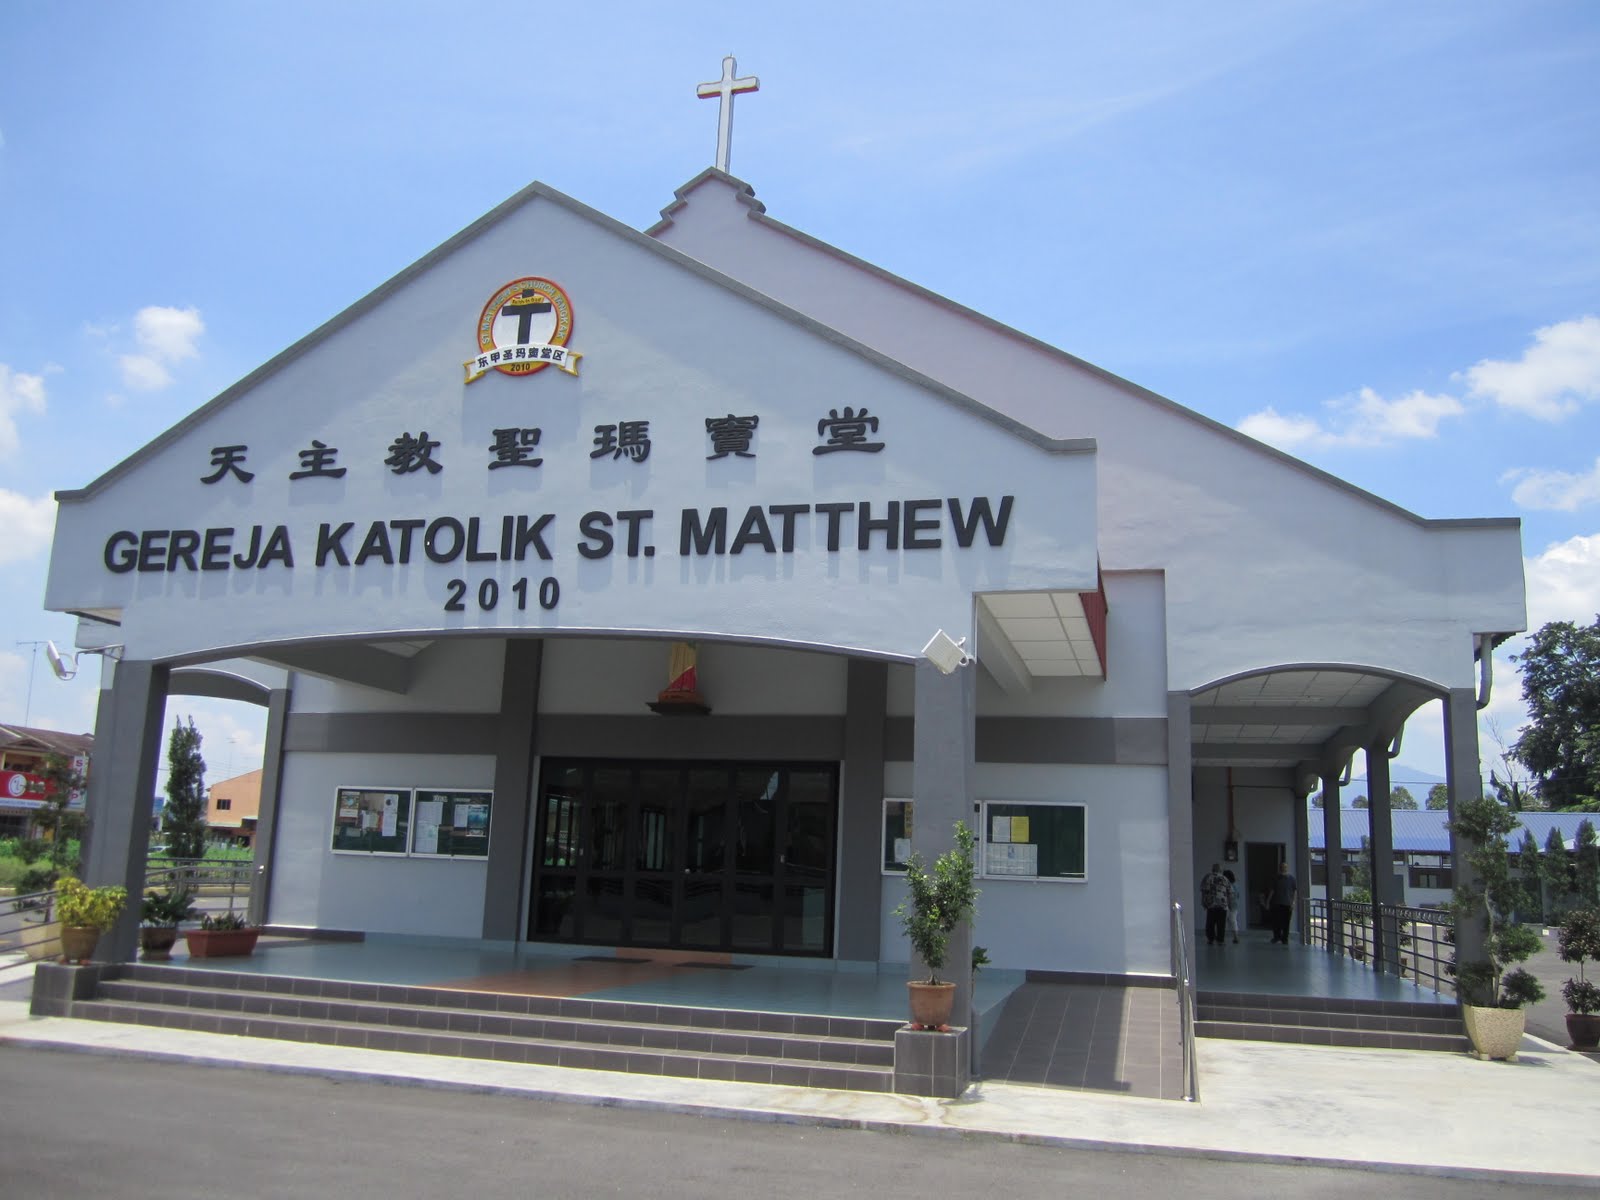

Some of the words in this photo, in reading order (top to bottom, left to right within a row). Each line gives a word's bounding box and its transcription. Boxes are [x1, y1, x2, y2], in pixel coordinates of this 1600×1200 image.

[521, 281, 556, 296] CHURCH
[511, 362, 530, 371] 2010
[104, 526, 294, 573] GEREJA
[315, 514, 556, 567] KATOLIK
[577, 510, 656, 560] ST.
[679, 496, 1014, 557] MATTHEW
[444, 577, 560, 611] 2010
